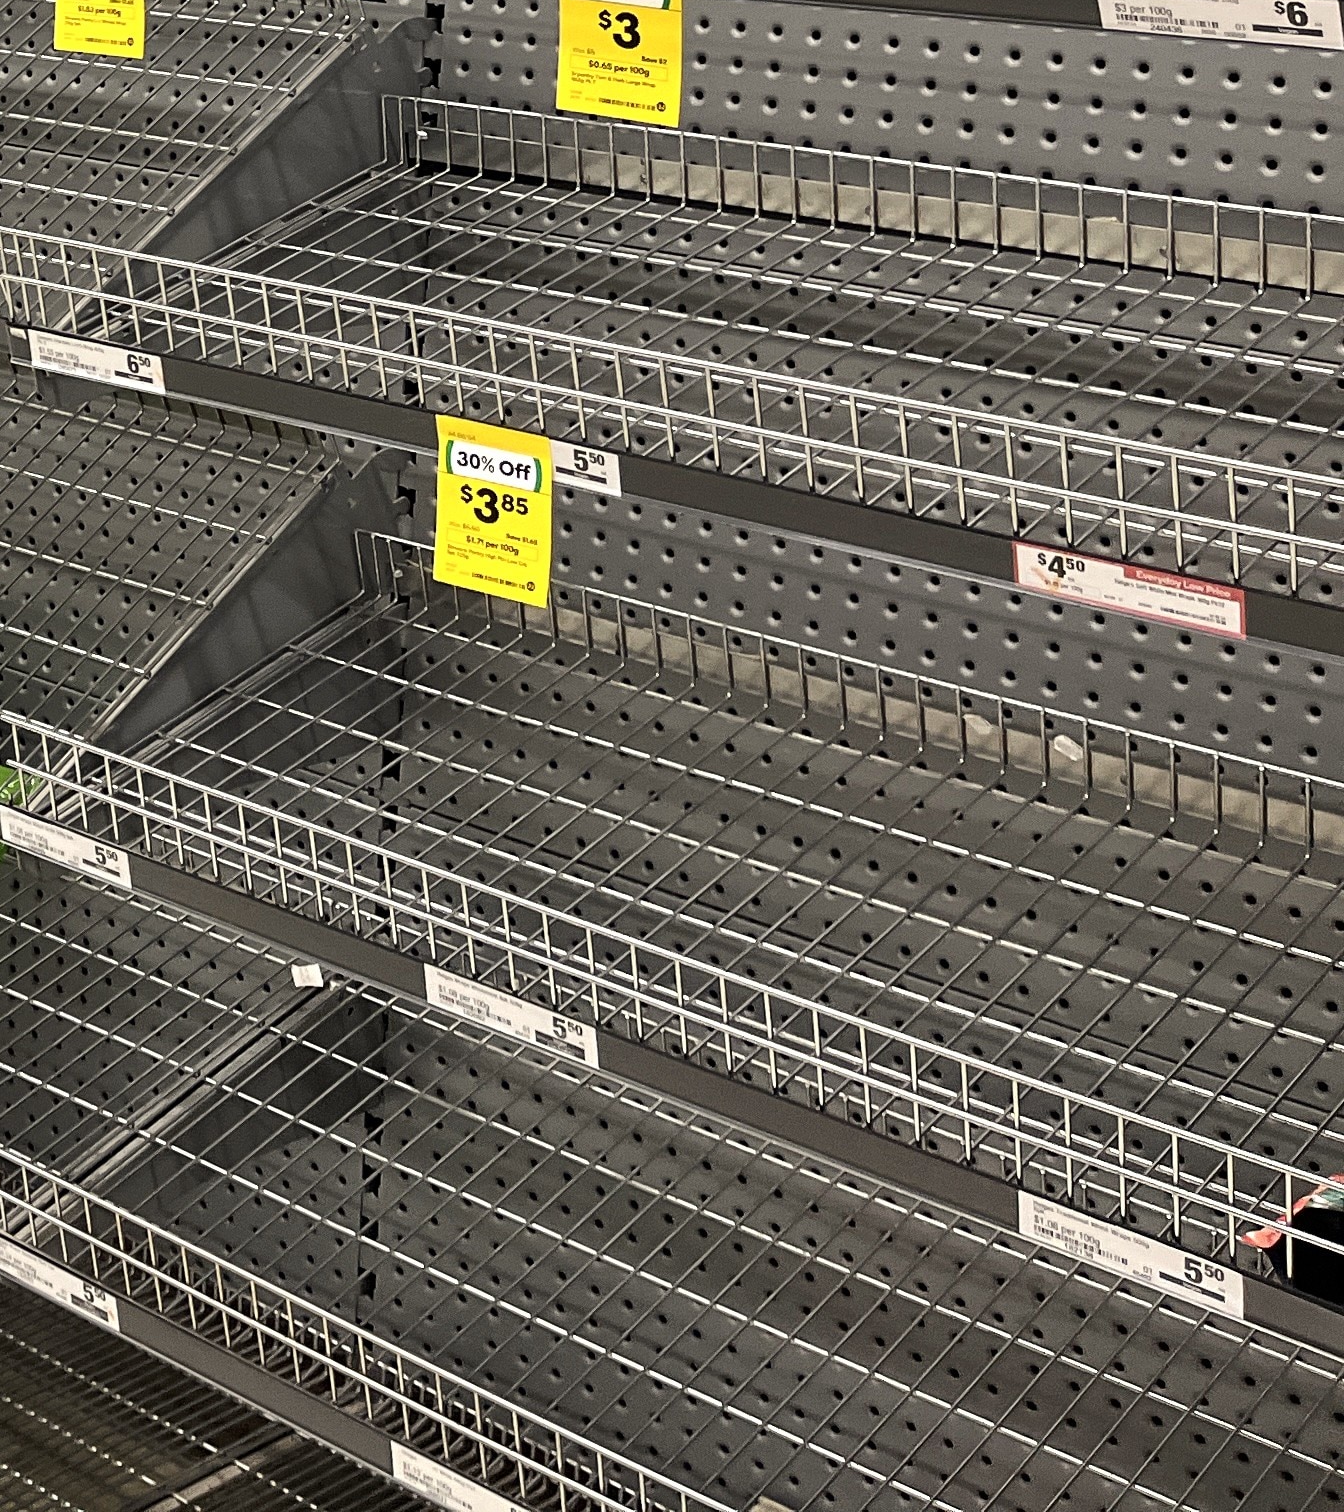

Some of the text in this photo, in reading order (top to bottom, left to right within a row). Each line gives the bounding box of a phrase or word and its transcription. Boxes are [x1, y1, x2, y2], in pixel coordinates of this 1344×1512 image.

[1115, 2, 1173, 17] $3 per 100g
[1274, 0, 1309, 27] $6
[598, 8, 641, 50] $3
[613, 65, 629, 74] per
[456, 450, 532, 481] 30% Off
[485, 541, 499, 549] per
[1060, 1224, 1078, 1240] per
